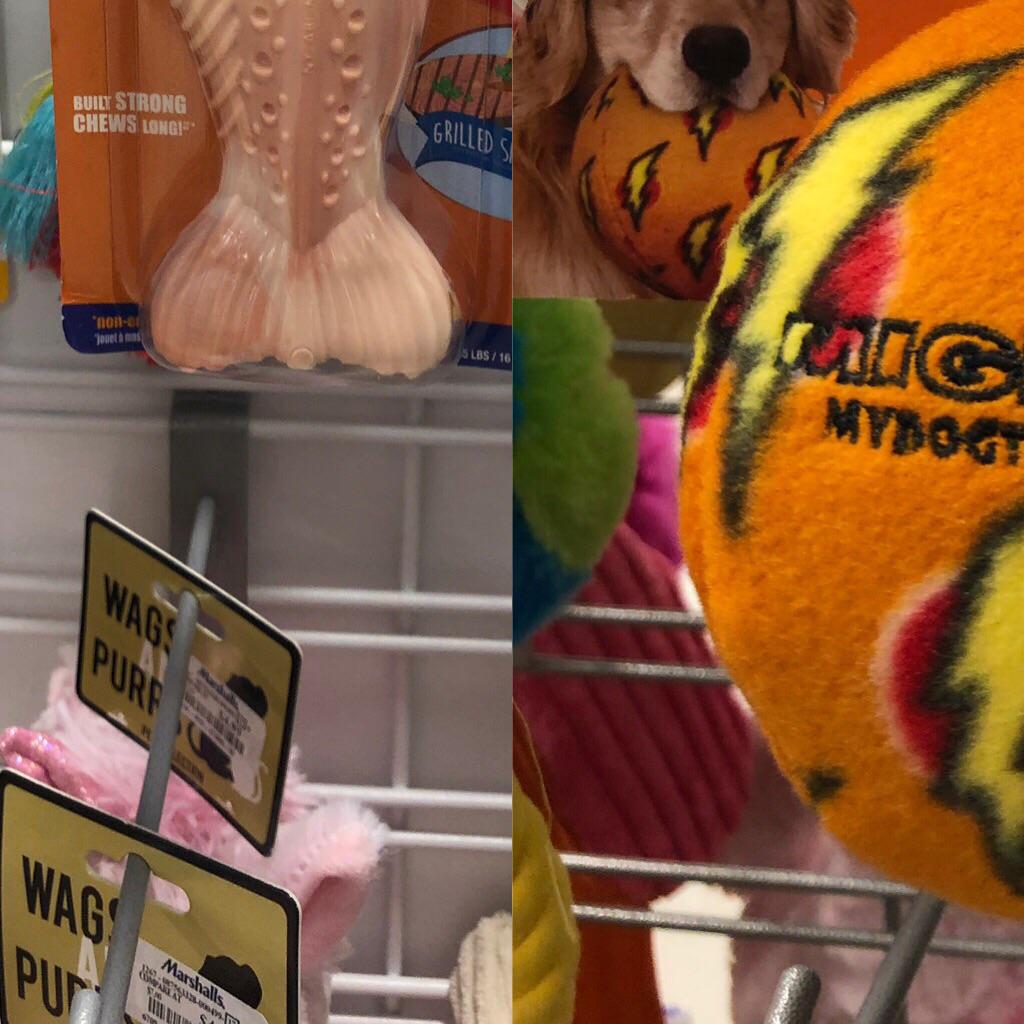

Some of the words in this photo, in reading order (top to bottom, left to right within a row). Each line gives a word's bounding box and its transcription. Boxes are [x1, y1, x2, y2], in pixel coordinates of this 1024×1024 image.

[73, 95, 112, 111] BUILT
[115, 91, 187, 114] STRONG
[73, 114, 137, 133] CHEWS
[433, 120, 494, 153] GRILLED
